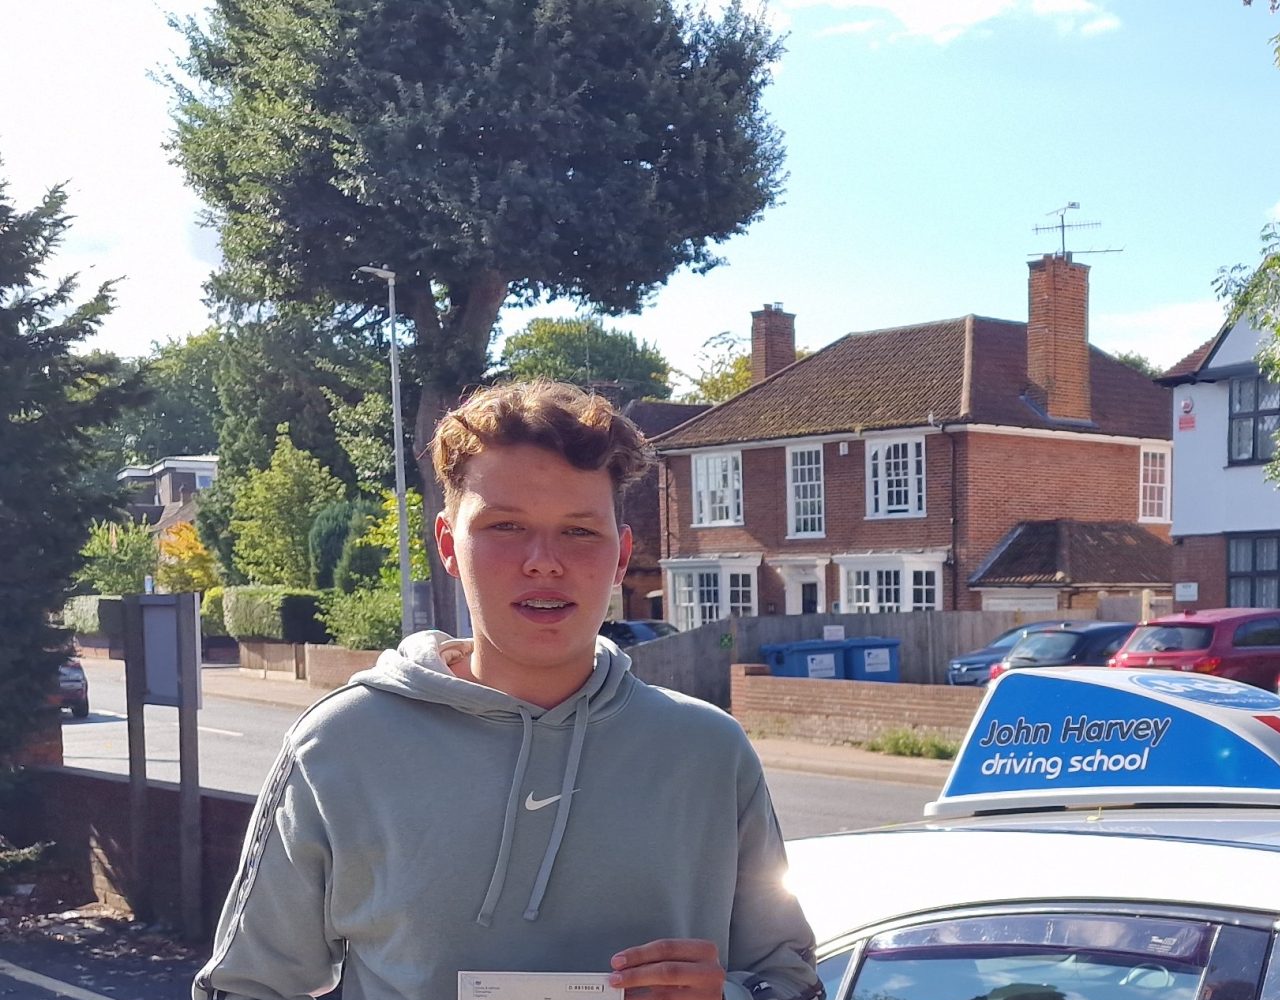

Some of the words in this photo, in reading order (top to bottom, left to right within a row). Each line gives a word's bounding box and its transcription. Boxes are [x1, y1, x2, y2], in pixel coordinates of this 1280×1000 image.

[980, 716, 1051, 747] John
[1060, 715, 1171, 747] Harvey
[981, 752, 1063, 780] driving
[1068, 747, 1150, 772] school
